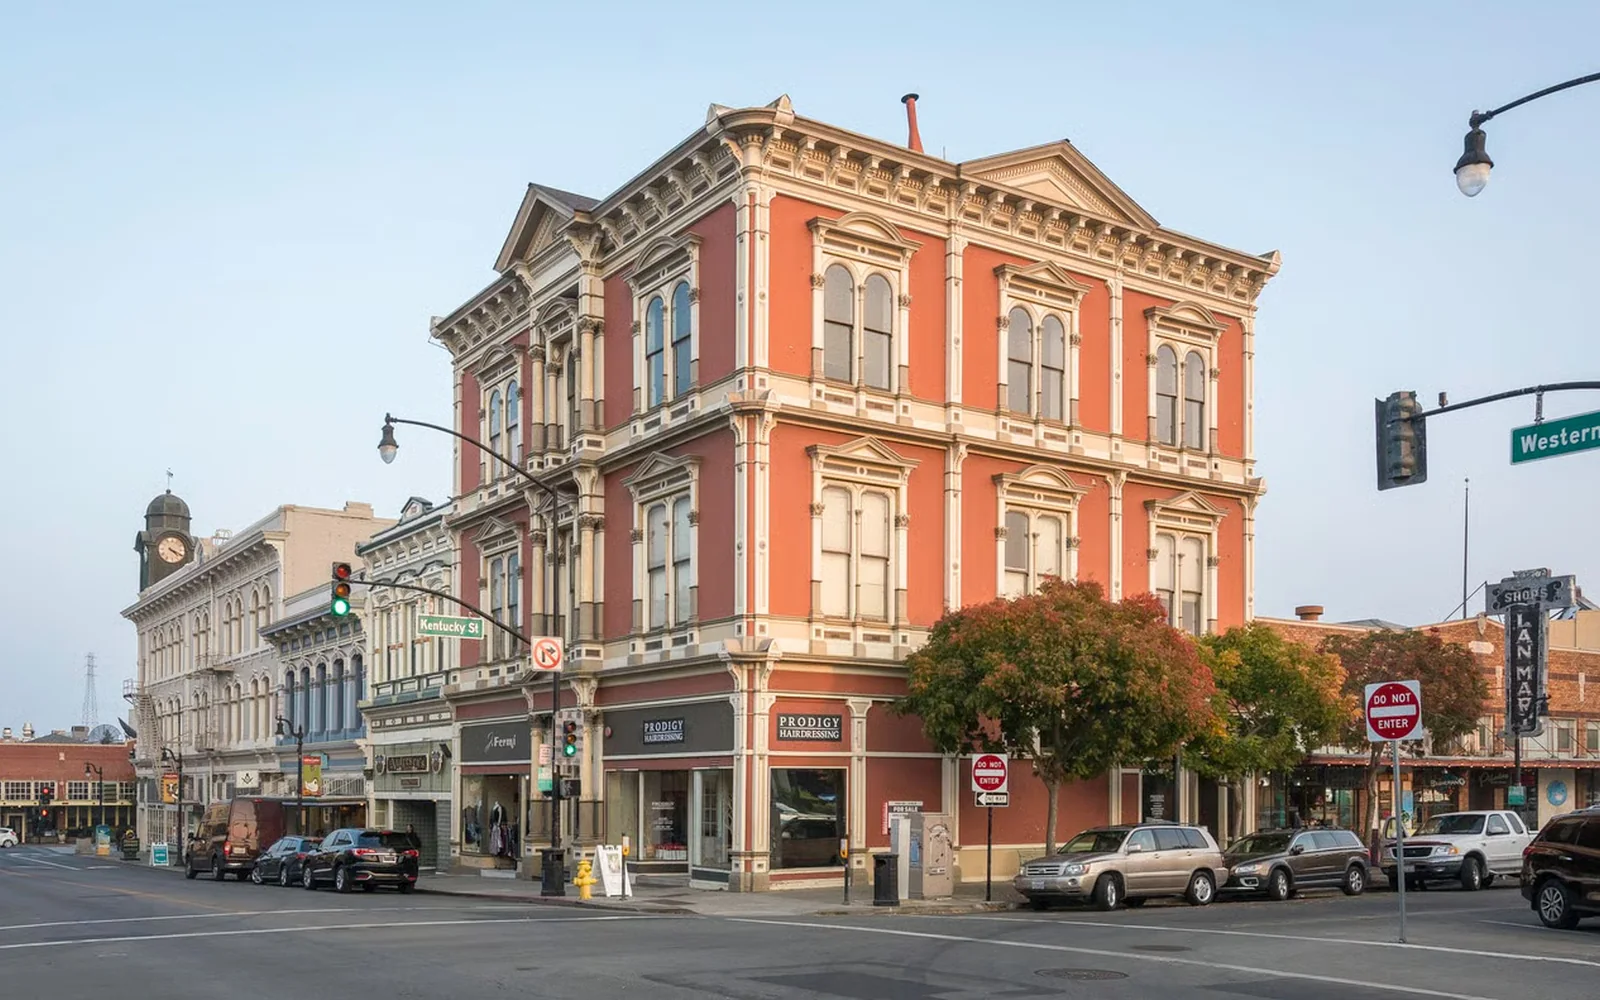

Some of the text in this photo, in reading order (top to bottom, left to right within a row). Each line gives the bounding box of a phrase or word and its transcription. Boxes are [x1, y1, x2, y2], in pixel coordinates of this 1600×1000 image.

[1520, 425, 1600, 454] Western
[1504, 587, 1549, 603] SHOPS
[420, 618, 479, 635] Kentucky St
[1373, 692, 1411, 705] DO NOT
[644, 720, 684, 732] PRODIGY
[779, 716, 840, 728] PRODIGY
[1378, 718, 1409, 729] ENTER
[779, 729, 840, 739] HAIRDRESSING
